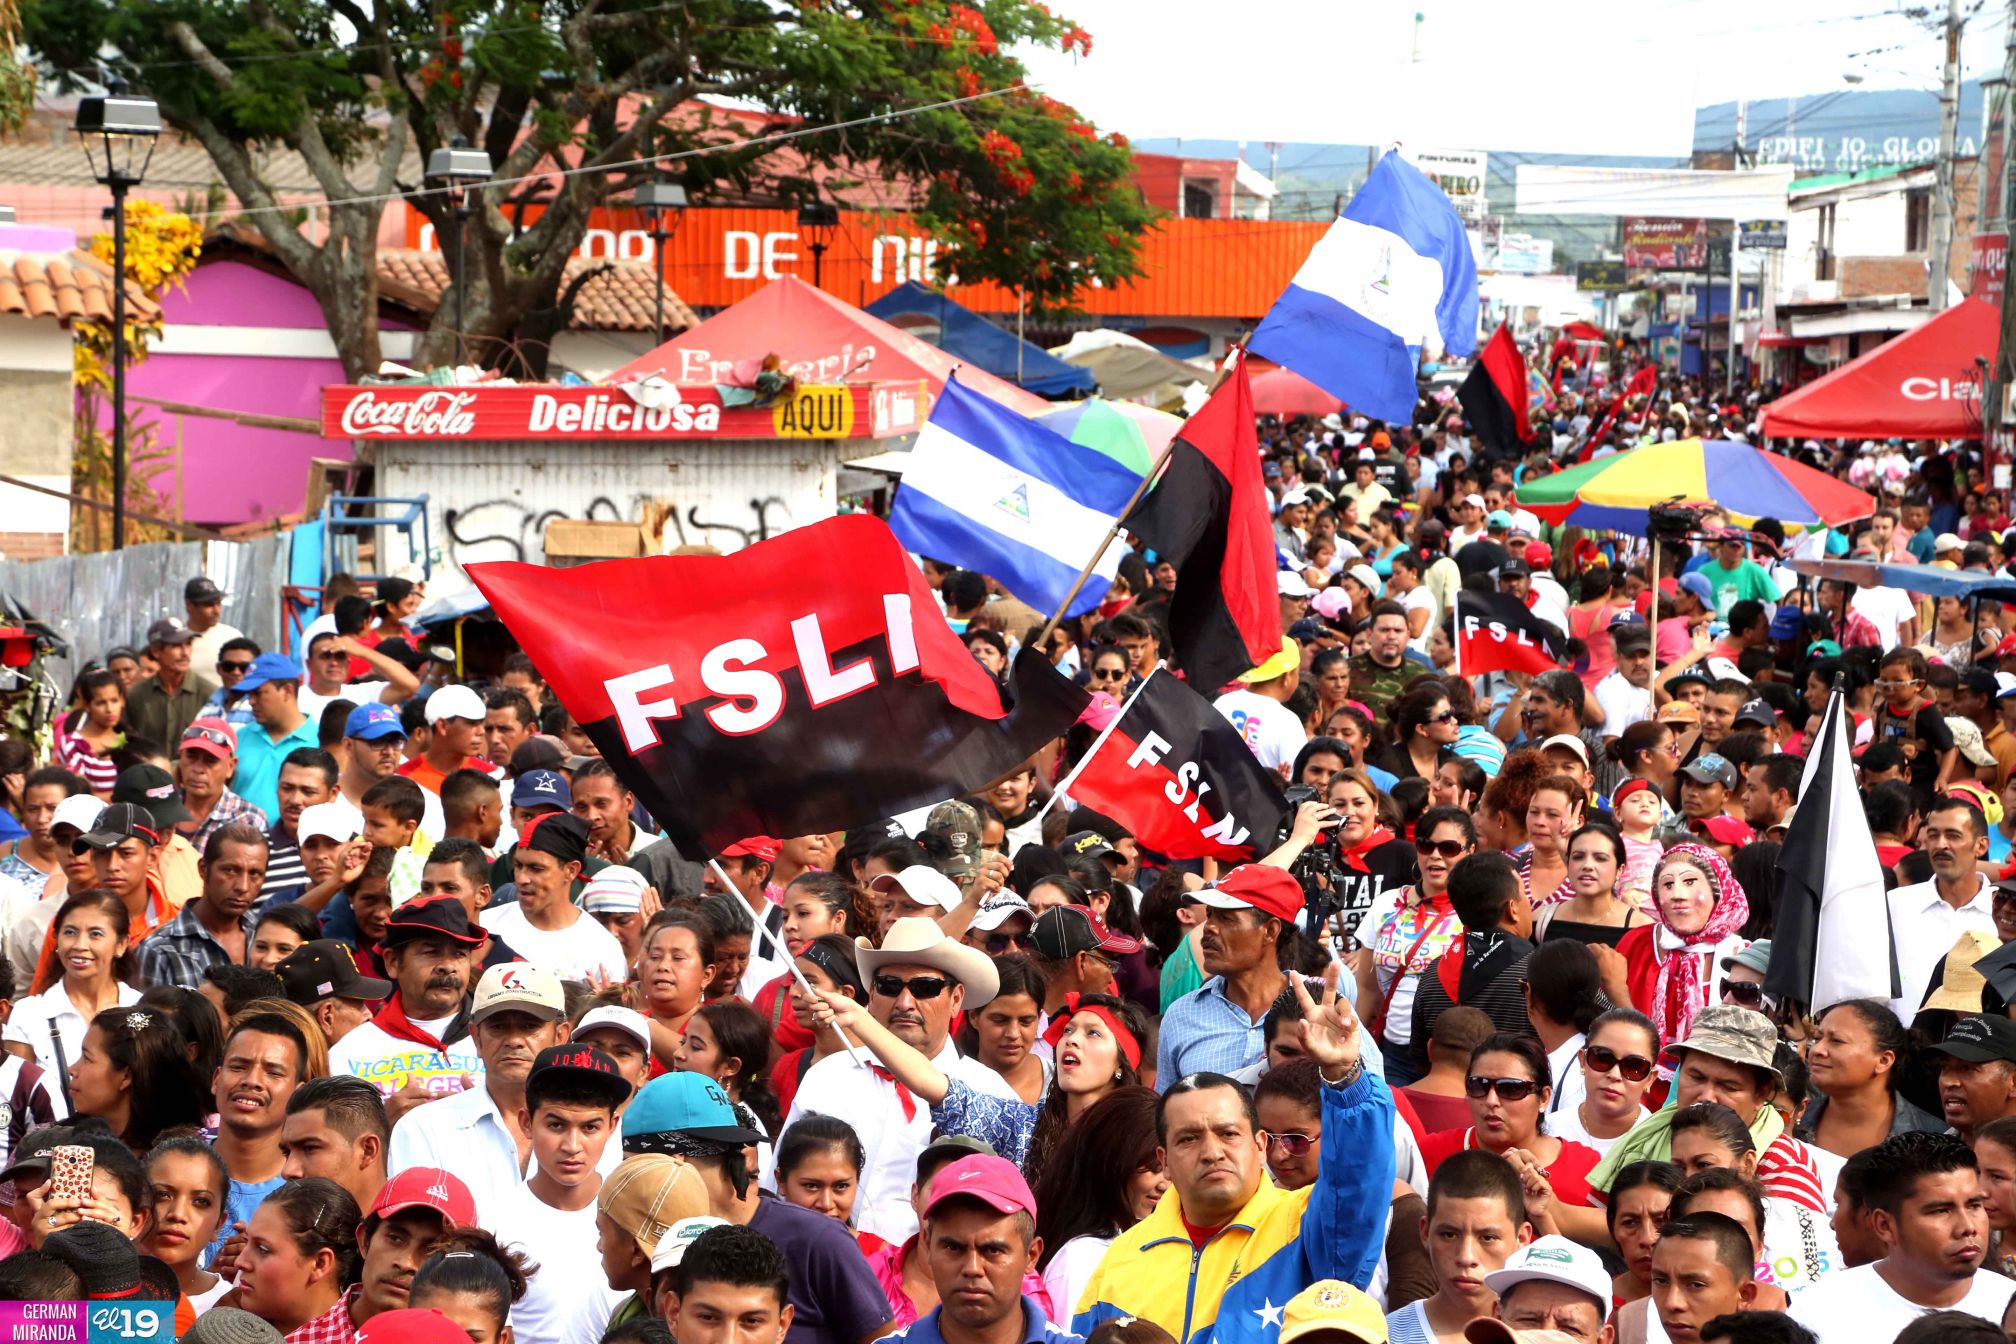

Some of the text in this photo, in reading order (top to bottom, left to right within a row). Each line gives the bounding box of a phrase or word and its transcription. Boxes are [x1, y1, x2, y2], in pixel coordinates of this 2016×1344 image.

[724, 230, 798, 280] DE
[1901, 377, 1984, 401] Cla
[341, 391, 479, 436] Coca-Cola
[528, 394, 720, 433] Deliciosa
[1126, 730, 1251, 846] FSLN
[348, 1052, 486, 1078] NICARAGU
